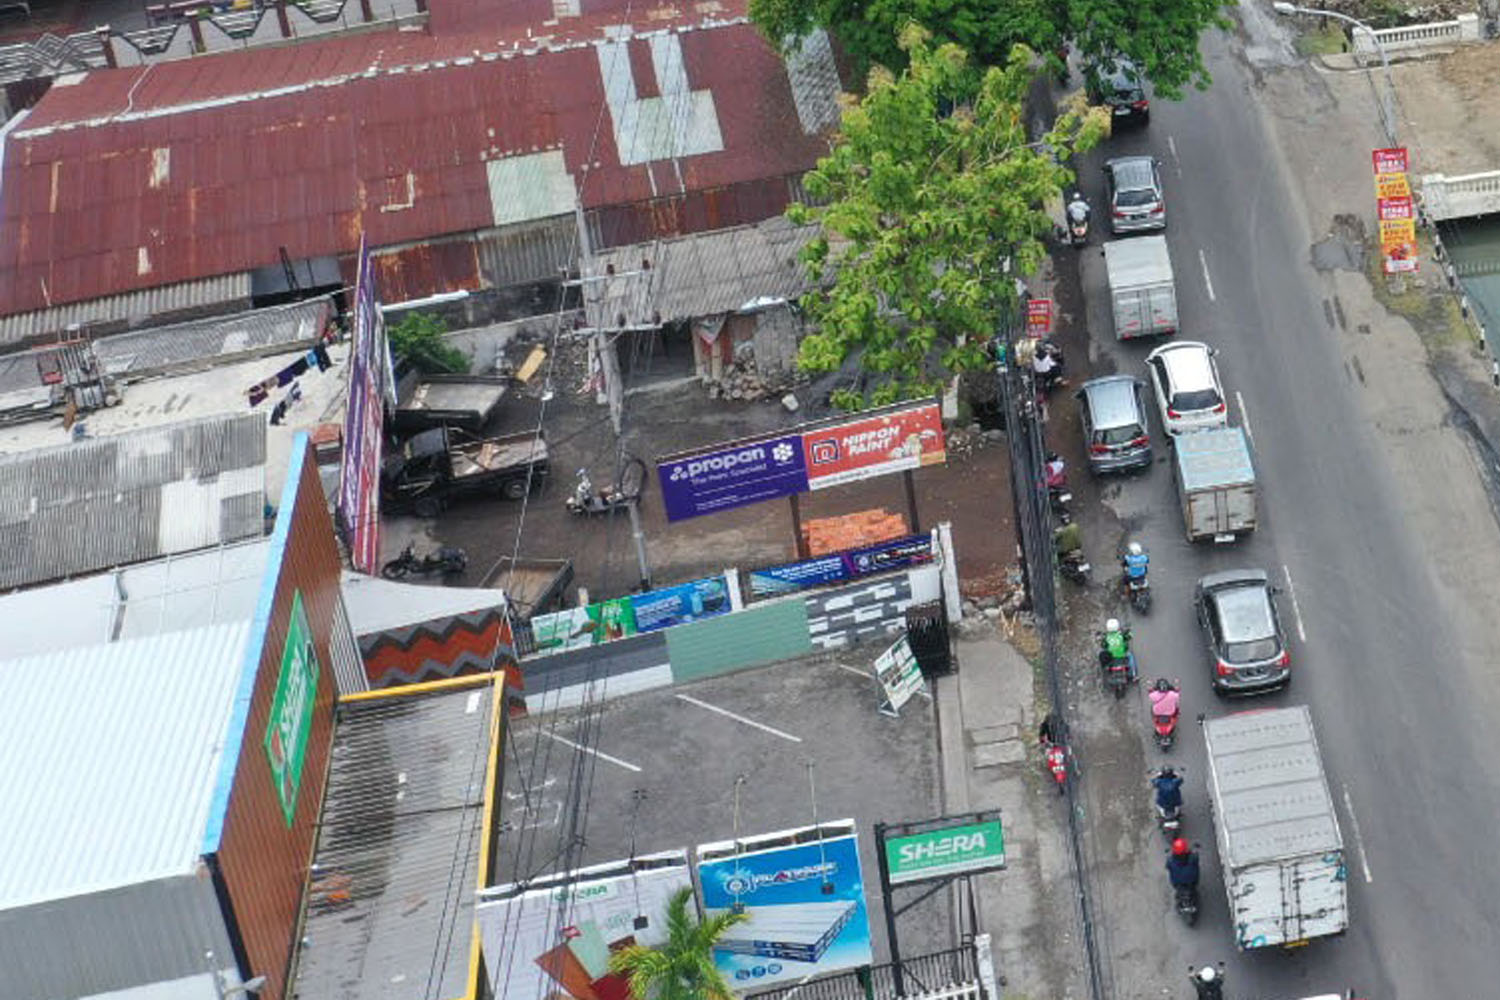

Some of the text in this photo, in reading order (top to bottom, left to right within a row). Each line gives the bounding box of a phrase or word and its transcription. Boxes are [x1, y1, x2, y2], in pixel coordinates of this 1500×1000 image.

[842, 426, 900, 448] NIPPON
[850, 438, 893, 457] PAINT
[688, 447, 766, 477] propan
[900, 832, 986, 862] SHERA
